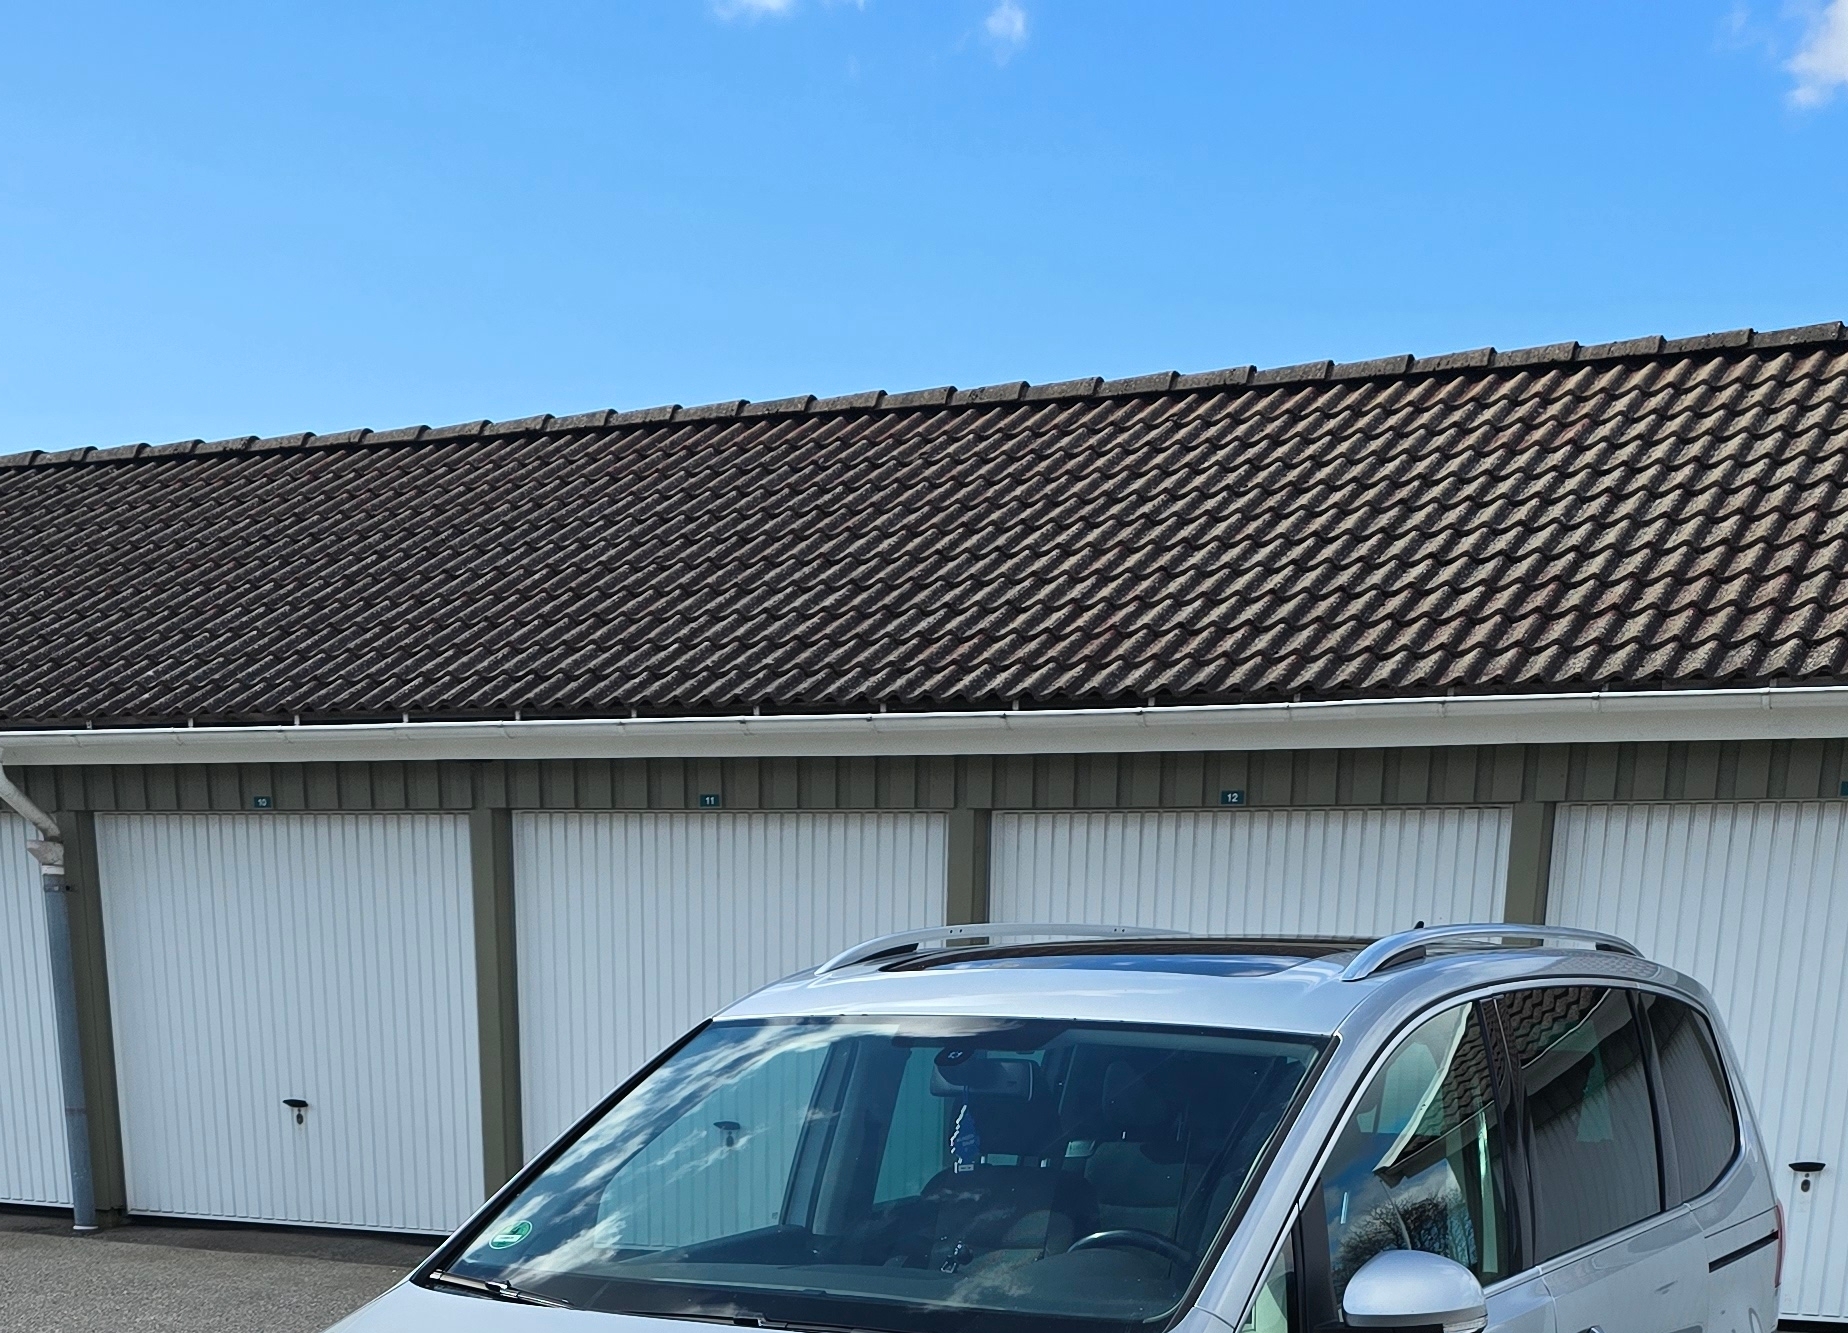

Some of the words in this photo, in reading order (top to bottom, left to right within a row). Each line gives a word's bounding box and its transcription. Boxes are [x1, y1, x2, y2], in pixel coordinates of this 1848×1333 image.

[257, 798, 267, 807] 10
[705, 796, 715, 805] 11
[1227, 793, 1239, 803] 12
